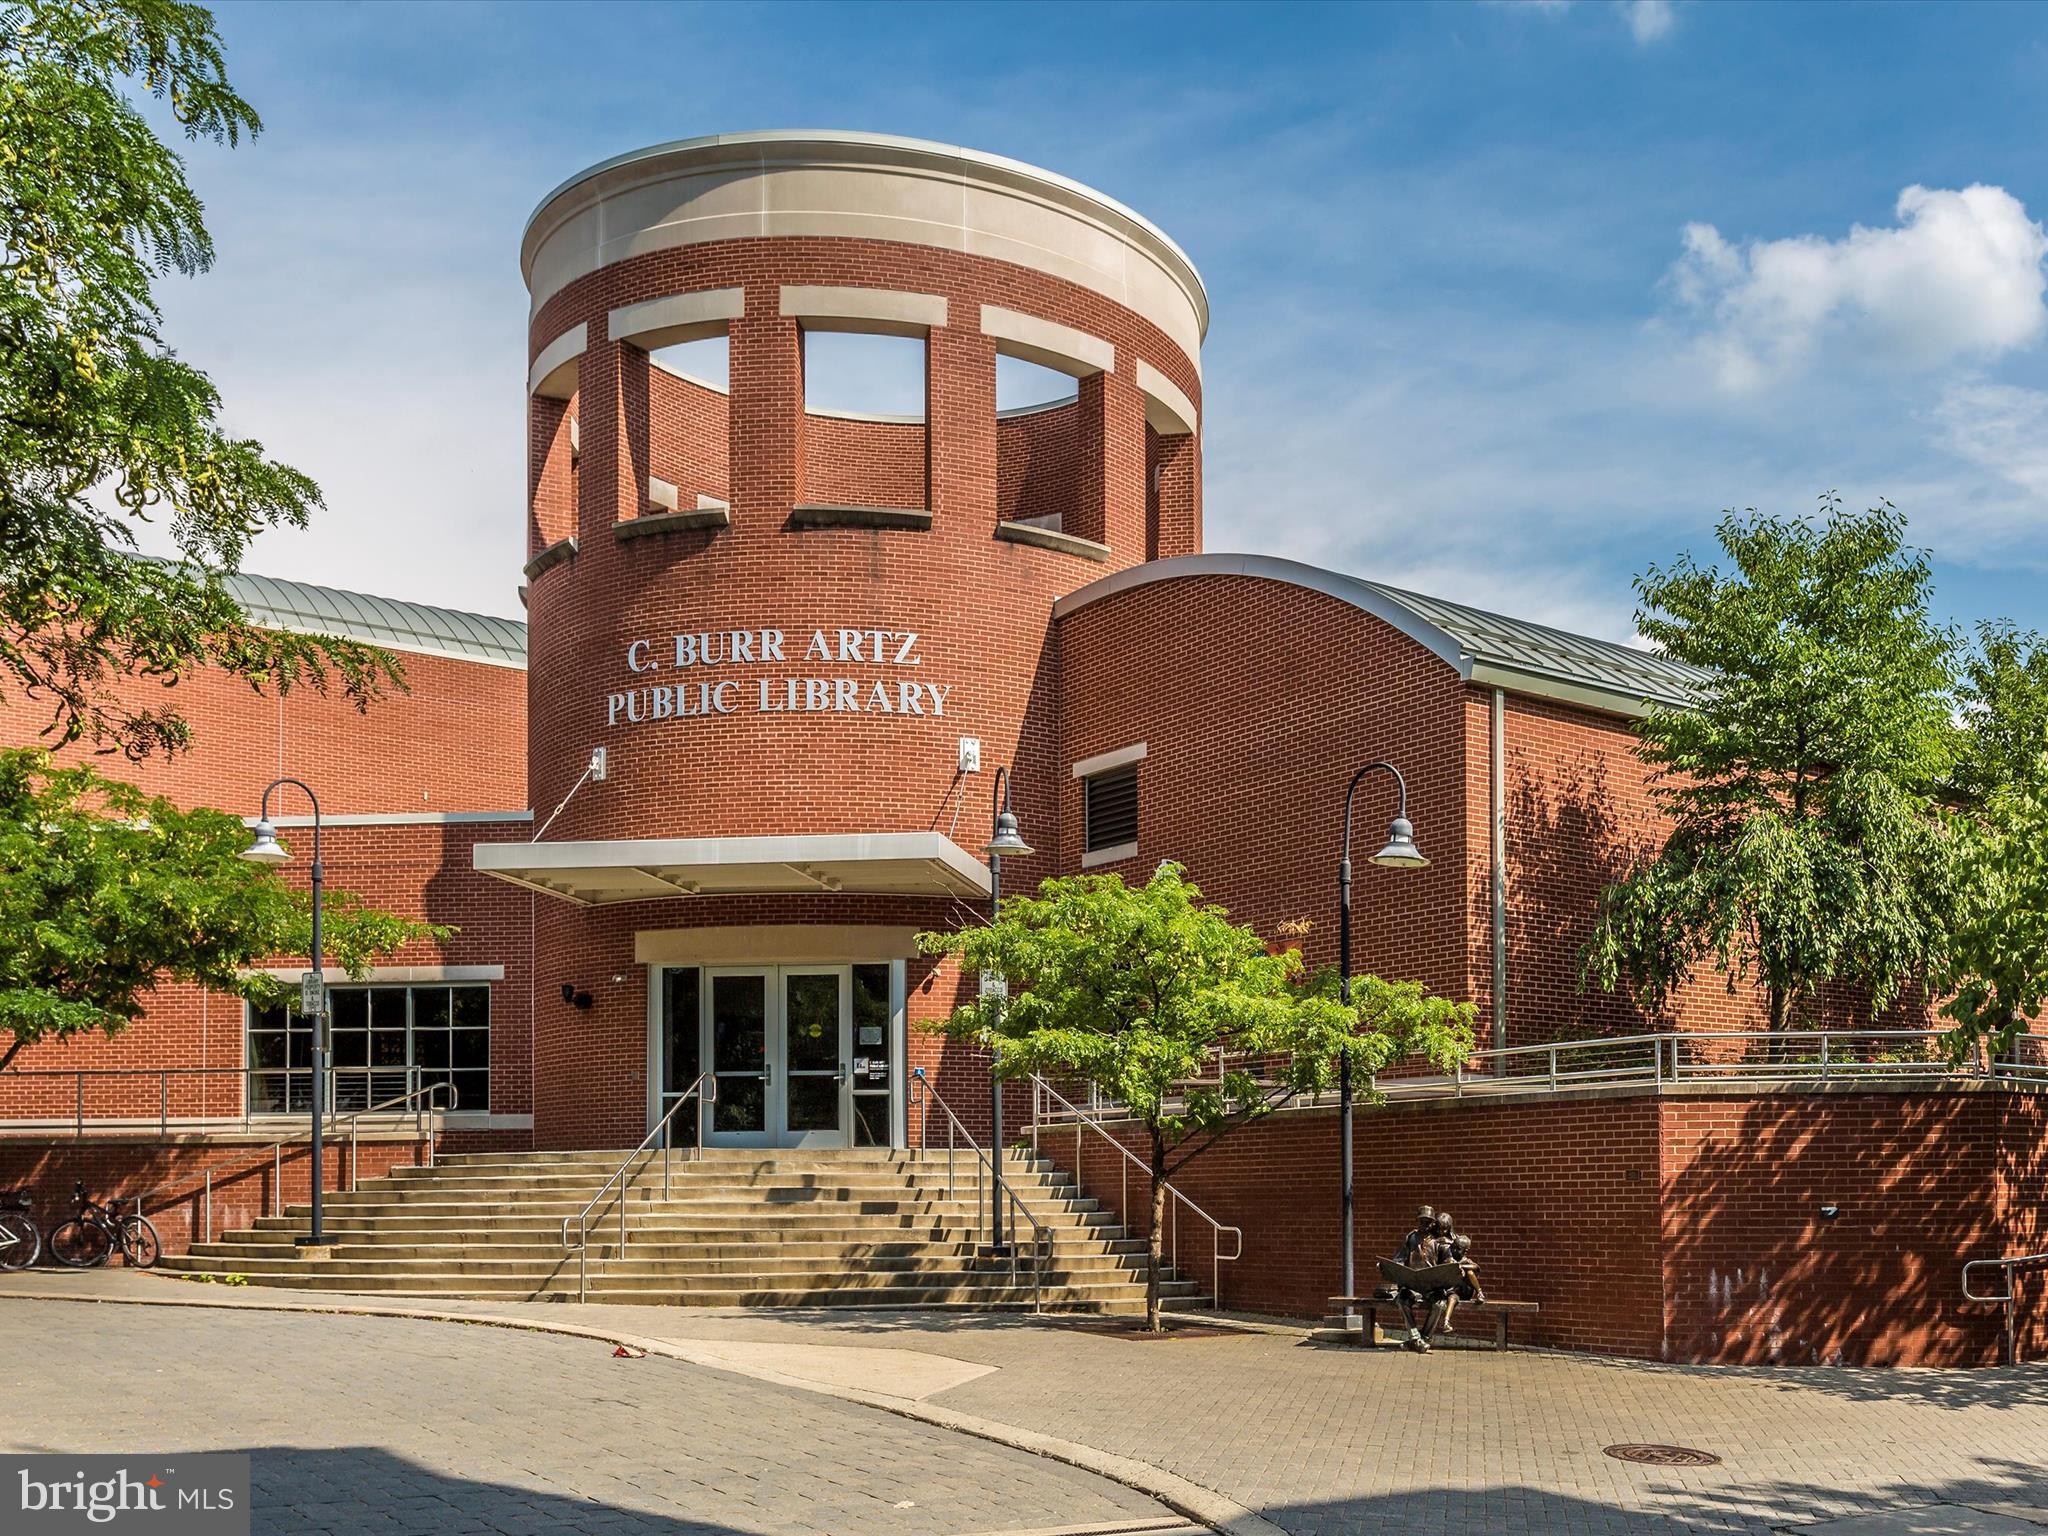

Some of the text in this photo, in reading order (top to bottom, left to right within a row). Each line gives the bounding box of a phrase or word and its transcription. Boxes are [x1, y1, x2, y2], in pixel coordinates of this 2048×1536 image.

[626, 628, 922, 674] C. BURR ARTZ
[605, 678, 953, 727] PUBLIC LIBRARY
